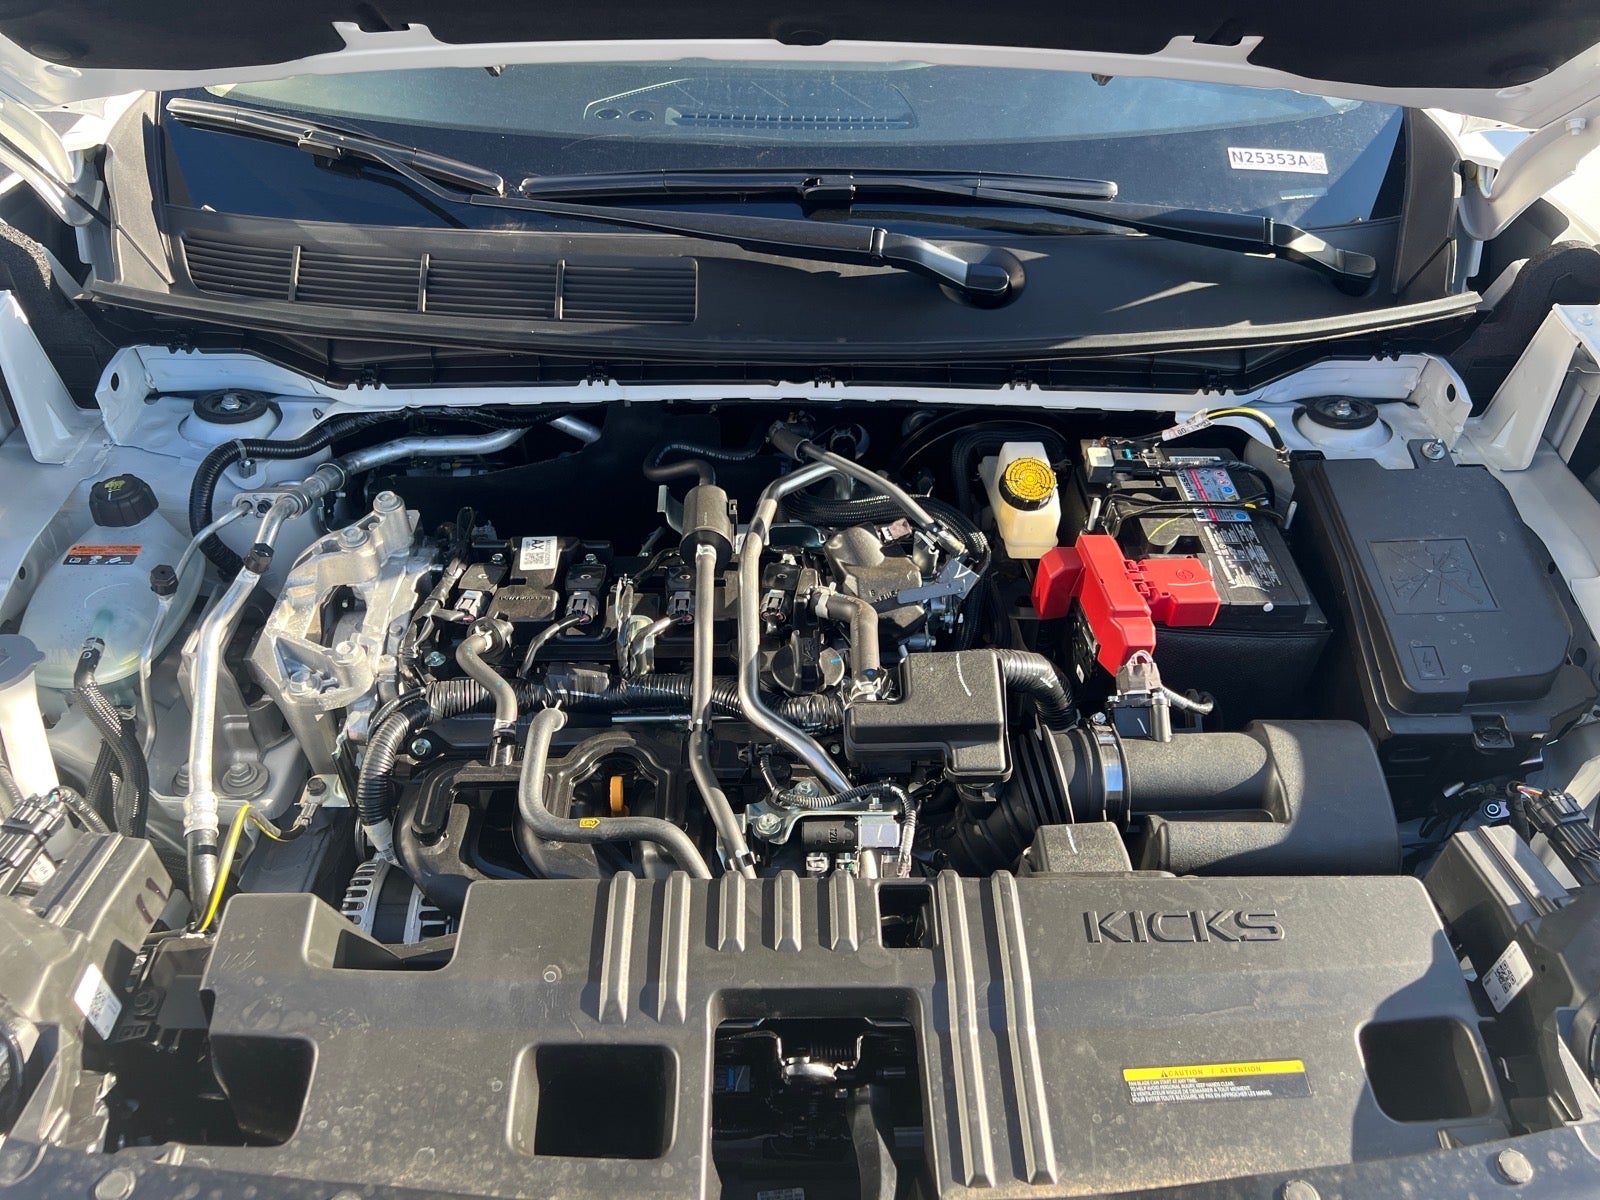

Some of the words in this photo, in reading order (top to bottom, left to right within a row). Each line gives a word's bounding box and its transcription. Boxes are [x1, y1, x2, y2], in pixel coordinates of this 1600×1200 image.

[1231, 151, 1309, 167] N25353A
[1082, 909, 1285, 944] KICKS
[1168, 1069, 1204, 1077] CAUTION
[1219, 1065, 1262, 1074] ATTENTION
